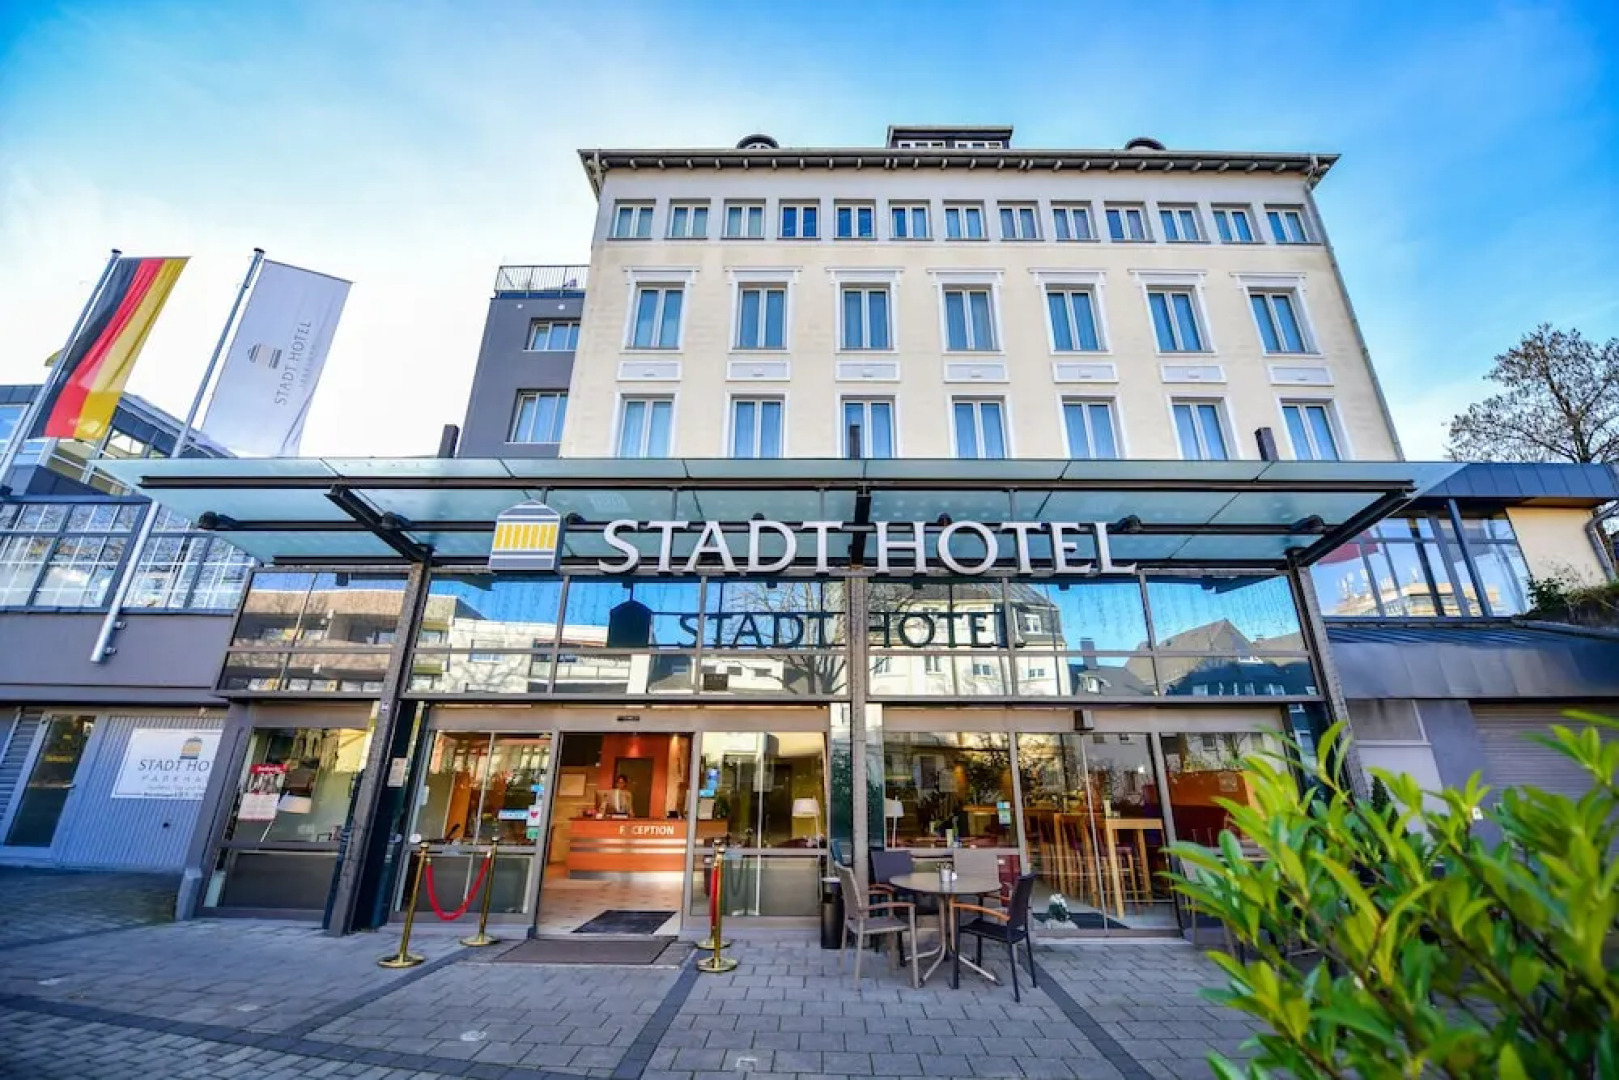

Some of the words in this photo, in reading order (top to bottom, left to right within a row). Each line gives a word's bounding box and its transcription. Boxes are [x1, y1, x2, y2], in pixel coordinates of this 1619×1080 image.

[274, 365, 297, 406] STADT
[287, 320, 312, 362] HOTEL
[598, 519, 844, 575] STADT
[874, 520, 1138, 575] HOTEL
[678, 611, 836, 649] STADT
[138, 759, 181, 772] STADT
[619, 825, 675, 836] RCEPTION
